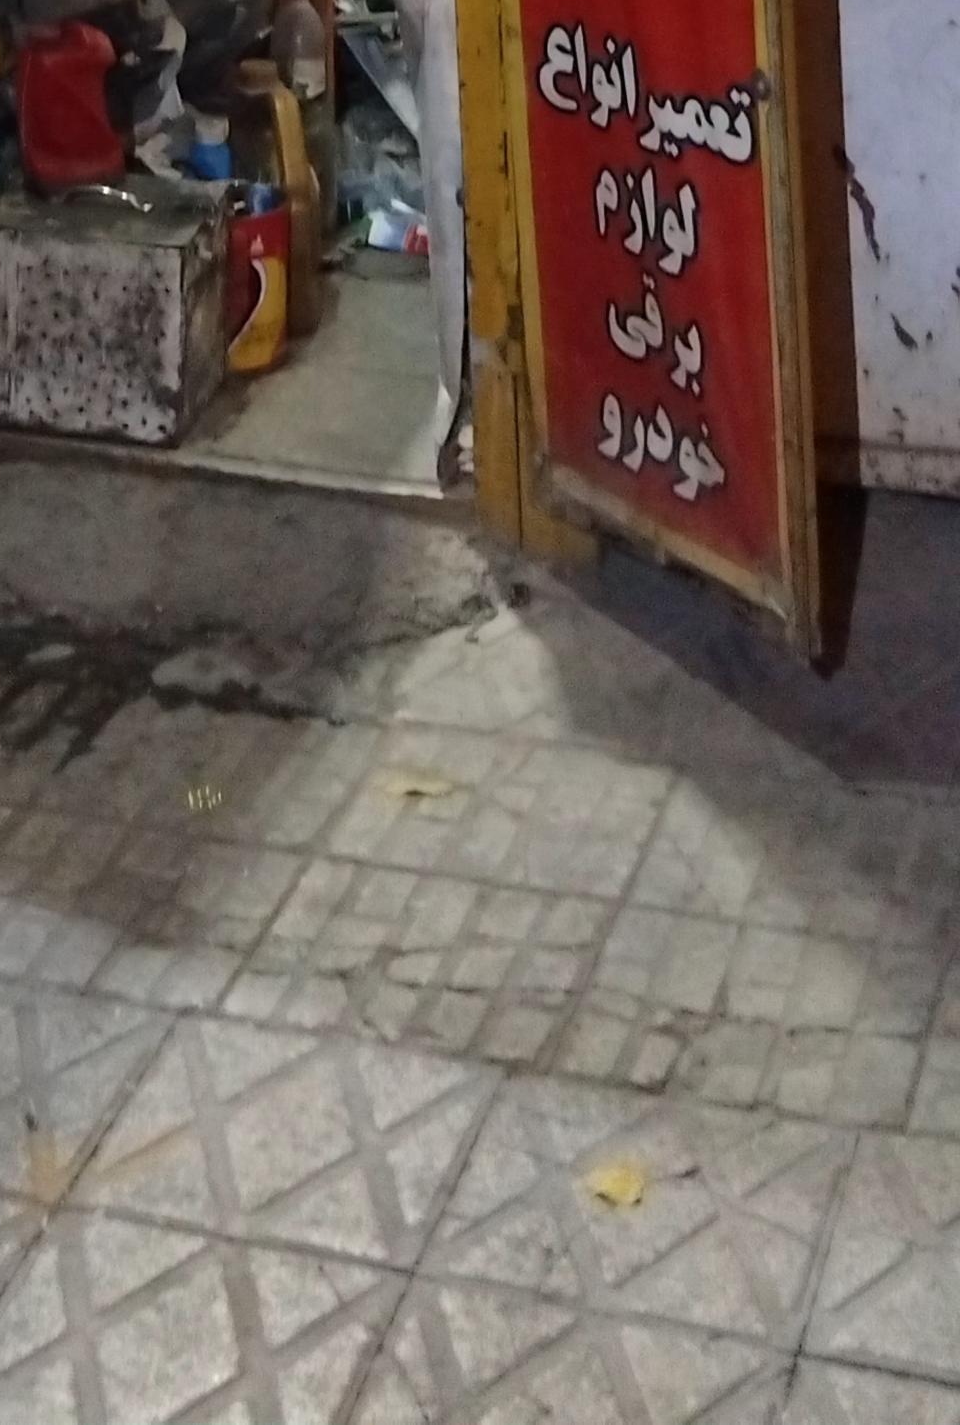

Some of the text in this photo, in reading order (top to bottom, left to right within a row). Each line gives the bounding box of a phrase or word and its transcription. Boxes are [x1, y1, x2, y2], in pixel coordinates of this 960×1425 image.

[539, 24, 754, 162] تعمیر انواع
[596, 168, 696, 275] لوازم
[597, 394, 726, 501] خودرو
